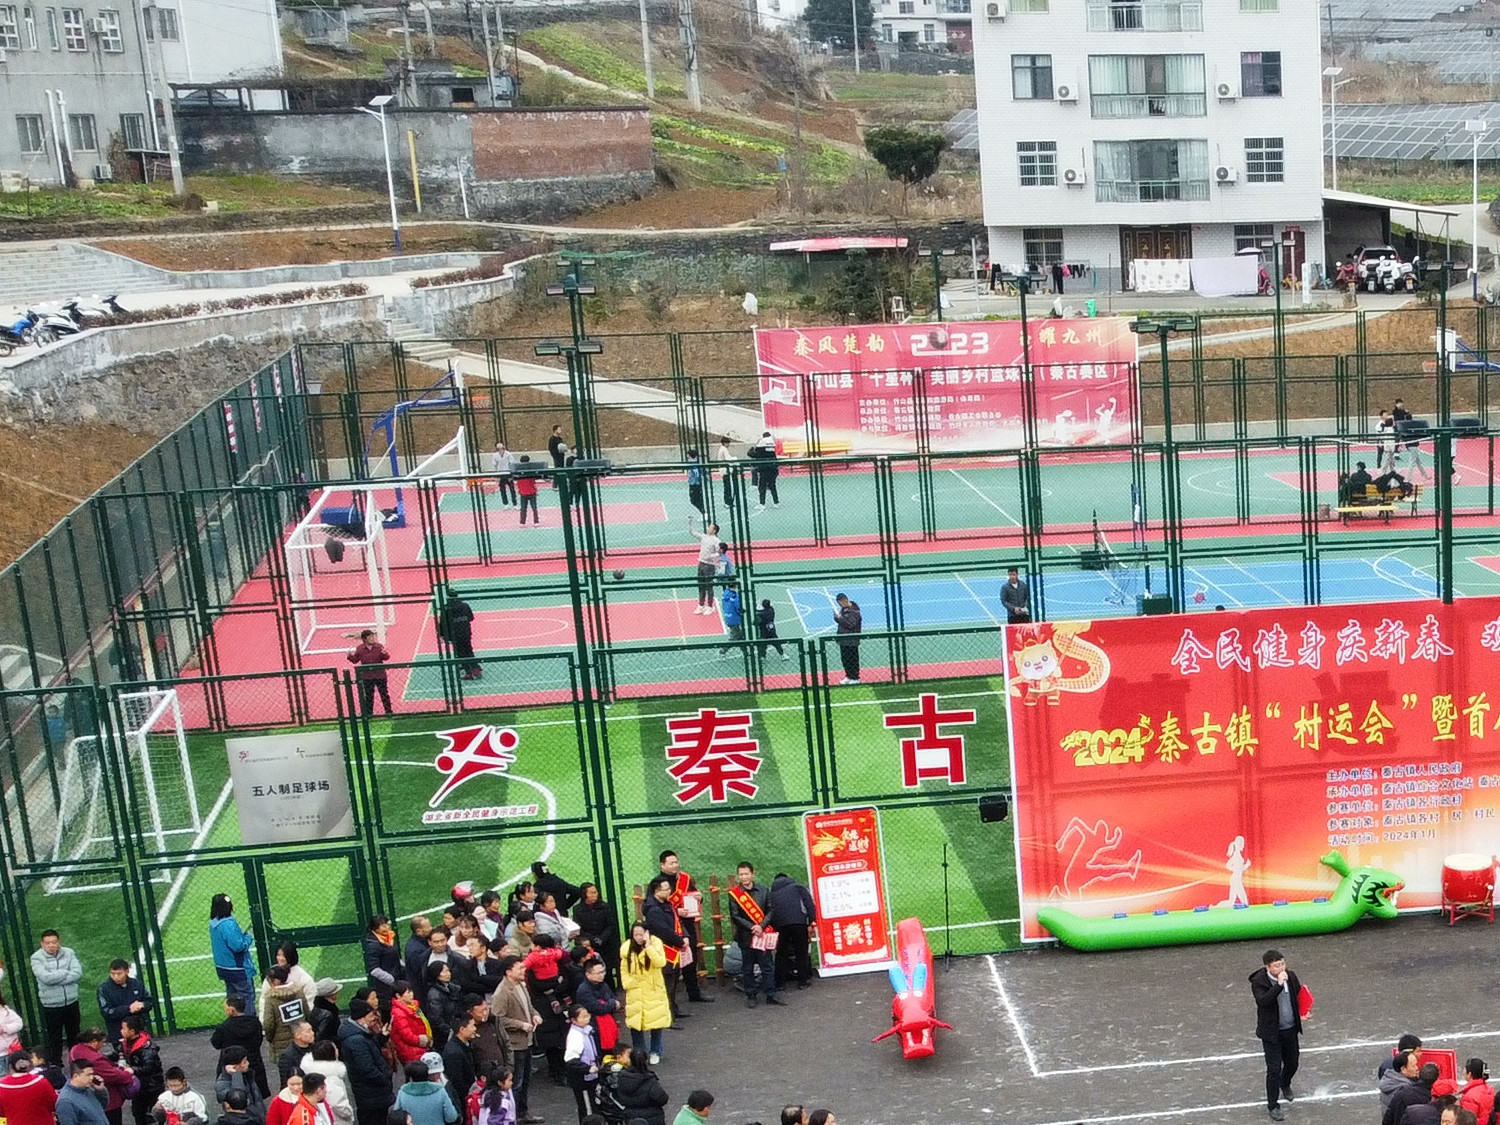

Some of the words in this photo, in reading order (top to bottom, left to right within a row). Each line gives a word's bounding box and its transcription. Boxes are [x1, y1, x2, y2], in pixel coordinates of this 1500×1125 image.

[1171, 614, 1454, 675] 全民健身庆新春
[665, 708, 763, 804] 秦
[882, 692, 977, 788] 古
[252, 780, 331, 798] 五人制足球场
